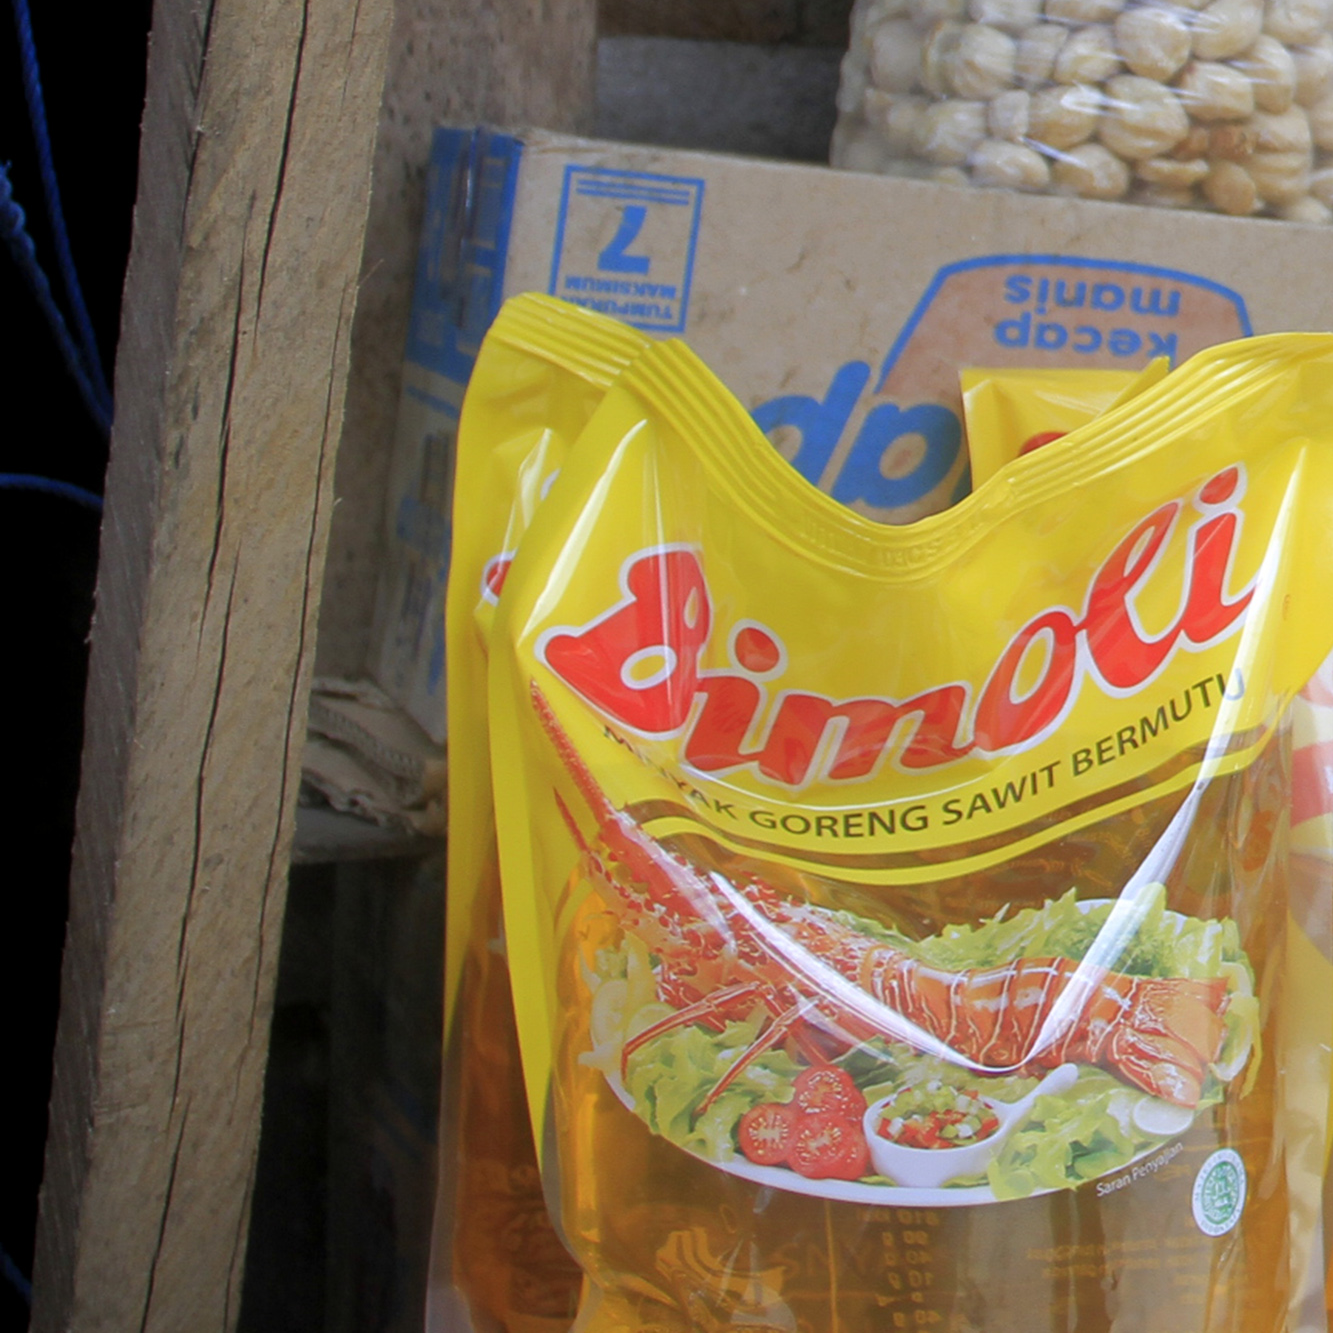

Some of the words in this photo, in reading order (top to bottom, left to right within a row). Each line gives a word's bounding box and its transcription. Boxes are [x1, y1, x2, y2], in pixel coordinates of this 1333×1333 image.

[597, 204, 651, 276] 7
[565, 275, 676, 300] MAKSIMUM
[1003, 274, 1182, 316] manis
[993, 311, 1179, 373] kecap
[541, 466, 1260, 785] Bimoli
[750, 804, 930, 839] GORENG
[942, 760, 1060, 825] SAWIT
[1071, 669, 1247, 778] BERMUTU
[1095, 1174, 1132, 1198] Saran
[1131, 1141, 1184, 1181] Penyajian
